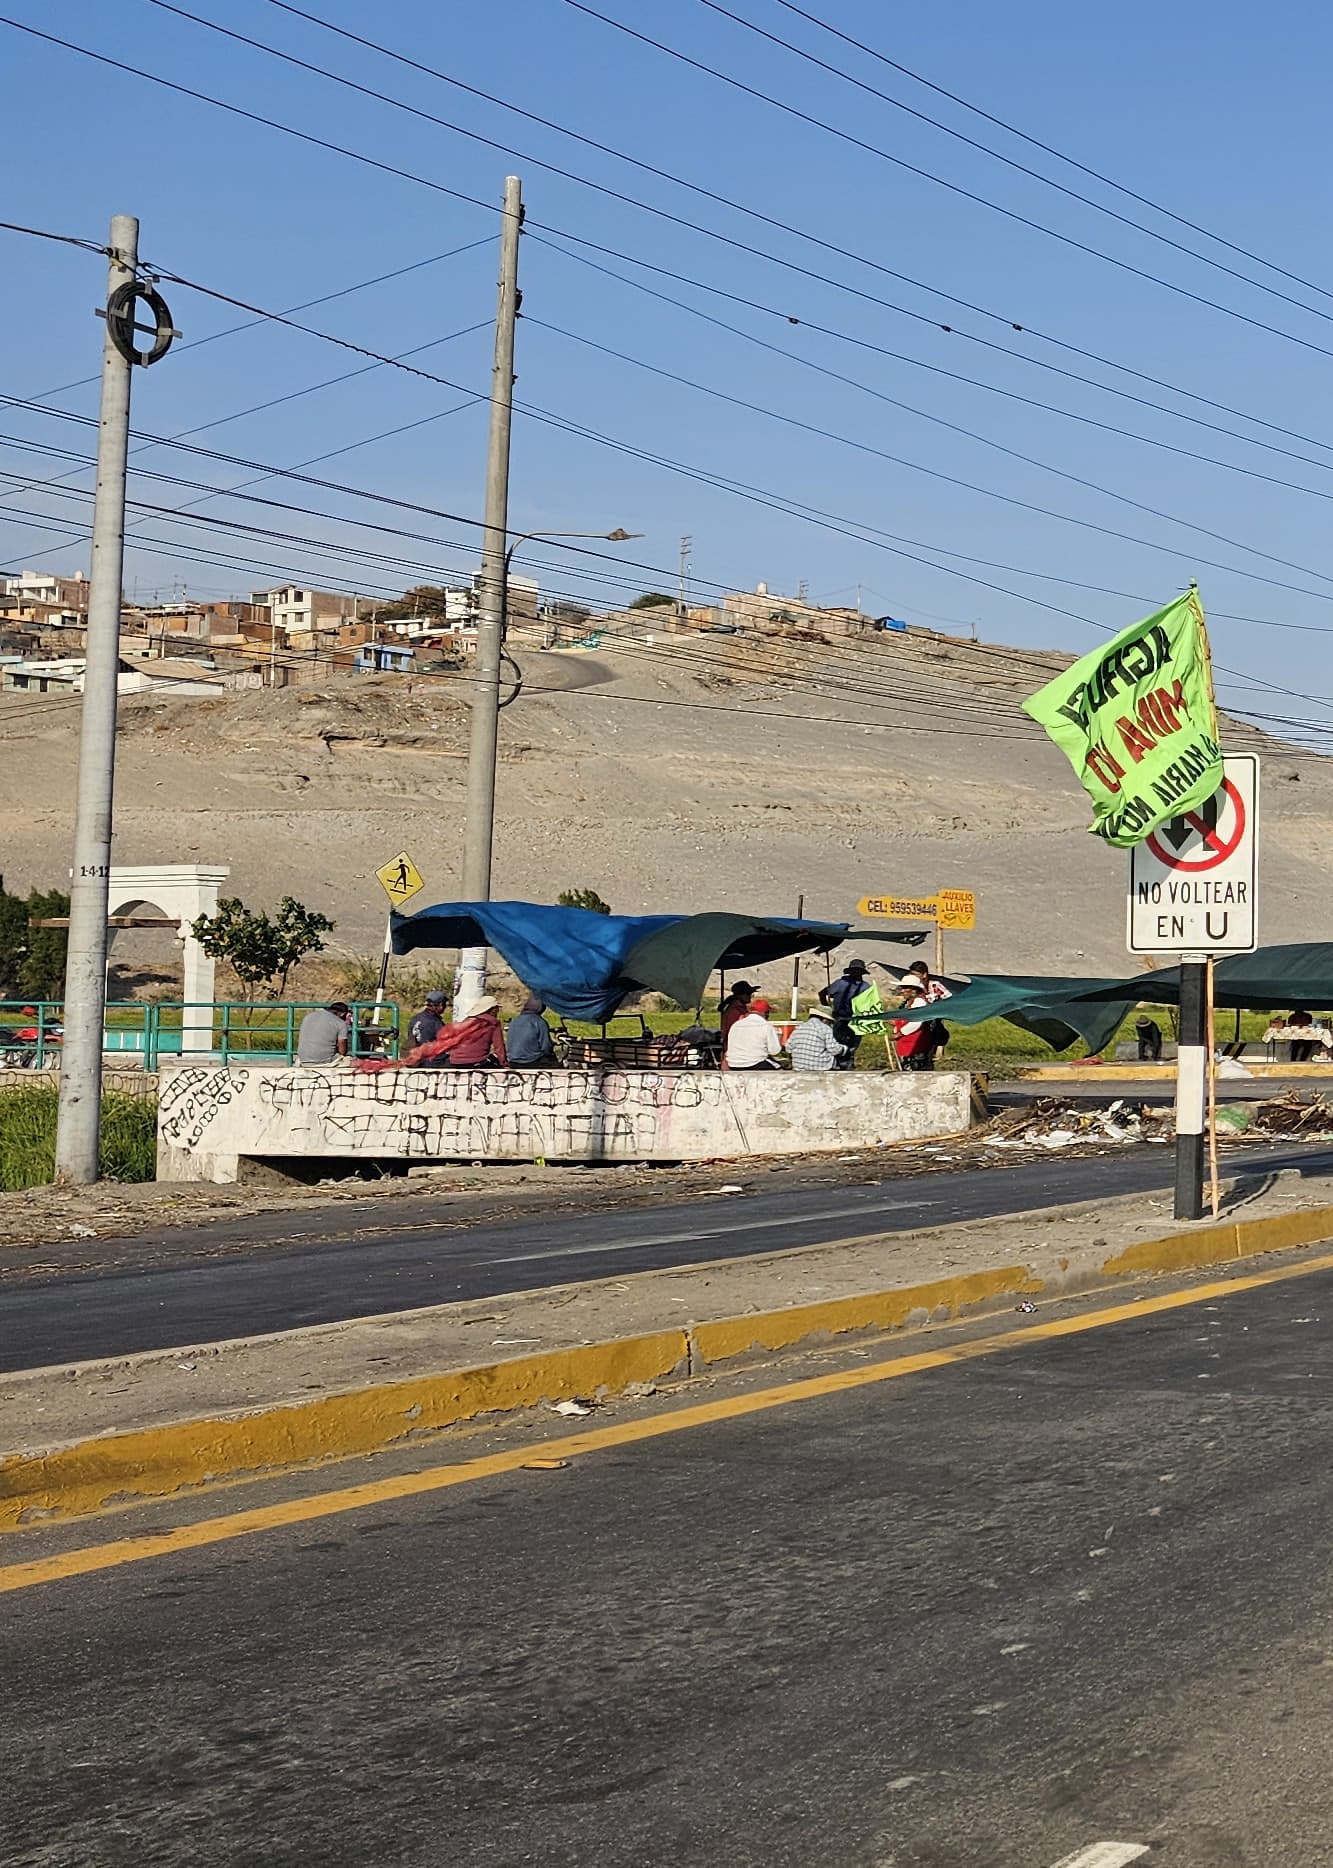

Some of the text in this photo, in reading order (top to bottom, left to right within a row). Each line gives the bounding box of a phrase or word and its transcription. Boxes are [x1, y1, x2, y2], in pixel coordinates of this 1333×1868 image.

[1138, 881, 1247, 904] NO VOLTEAR
[1157, 911, 1228, 940] EN U
